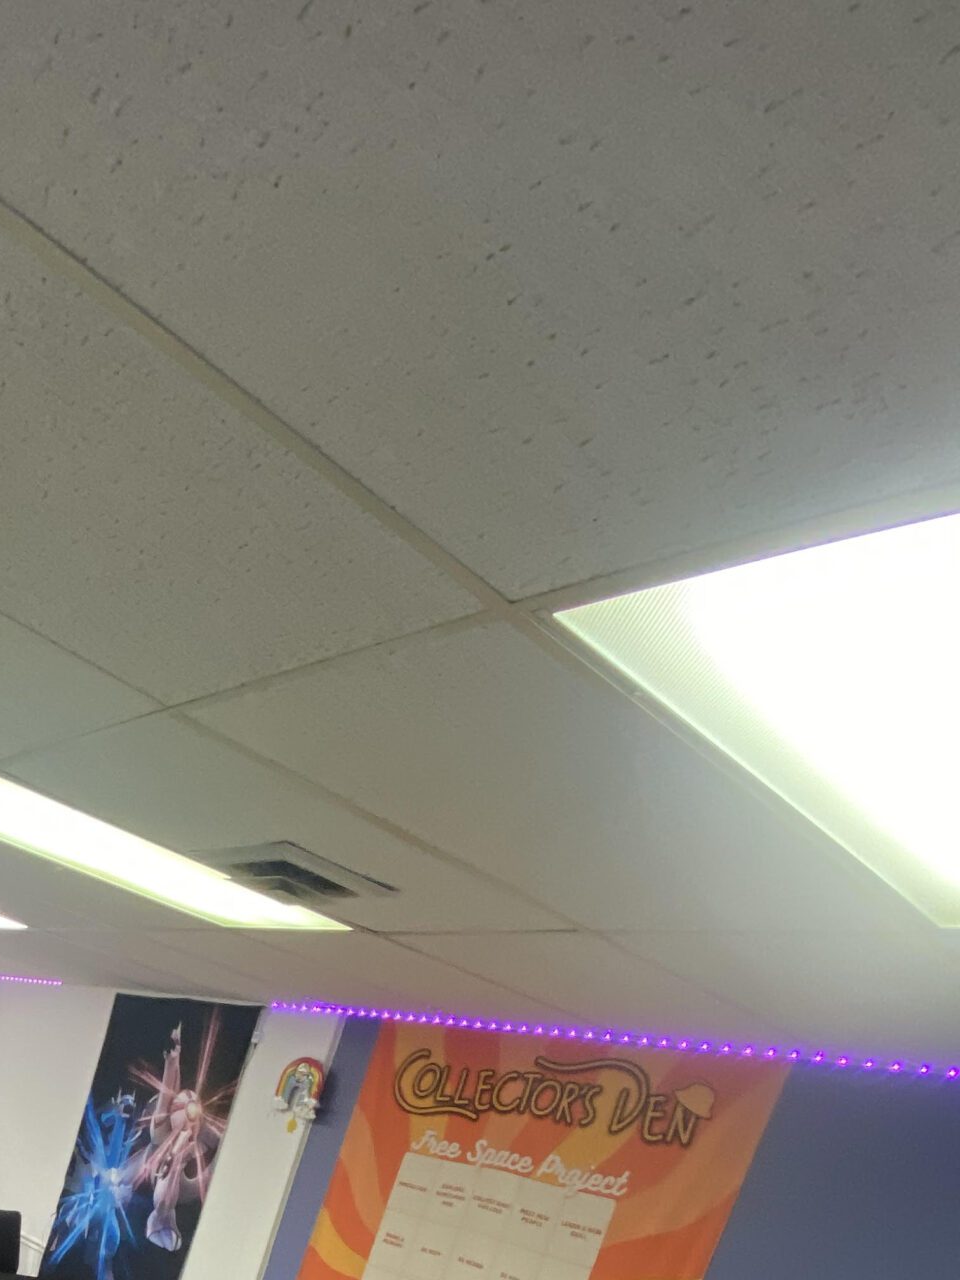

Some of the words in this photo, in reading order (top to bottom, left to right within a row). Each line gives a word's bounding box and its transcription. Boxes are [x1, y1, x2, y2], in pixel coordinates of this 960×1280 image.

[535, 1055, 705, 1146] DEN
[411, 1129, 463, 1160] Free
[466, 1138, 535, 1174] Space
[539, 1154, 632, 1198] Project
